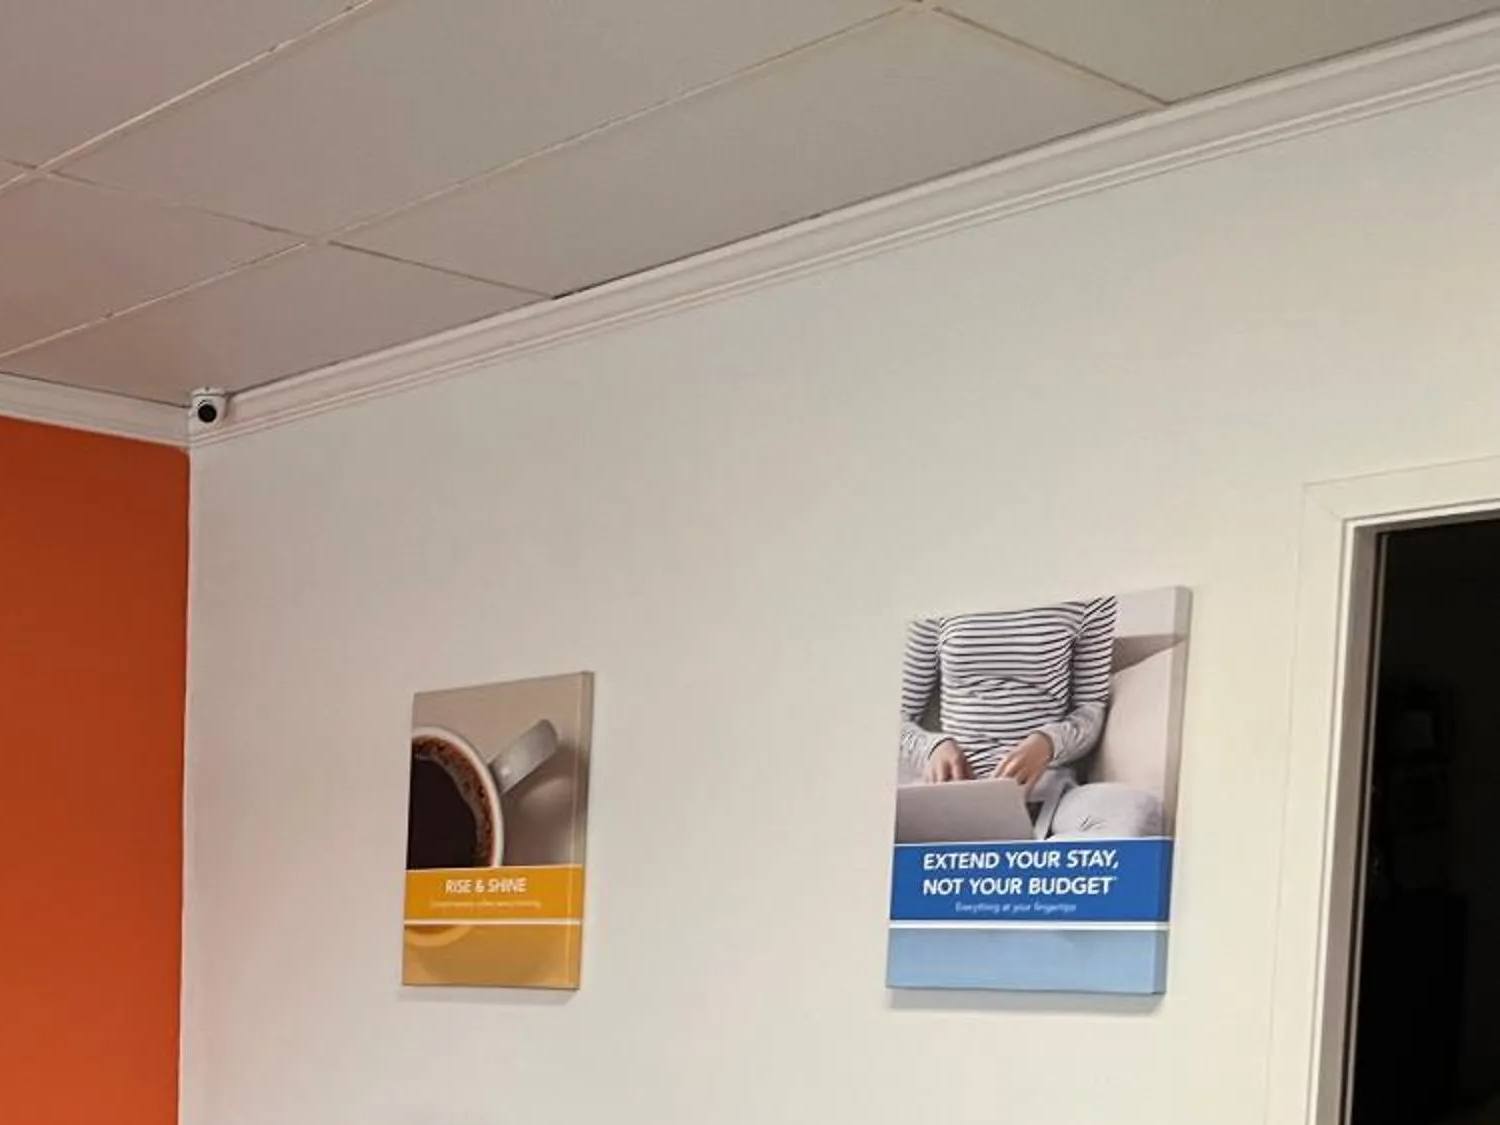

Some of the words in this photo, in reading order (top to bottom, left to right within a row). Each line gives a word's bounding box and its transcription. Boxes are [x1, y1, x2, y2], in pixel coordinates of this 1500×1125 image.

[923, 851, 1000, 870] EXTEND
[1005, 850, 1060, 869] YOUR
[1066, 849, 1119, 869] STAY,
[445, 878, 473, 894] RISE
[475, 879, 486, 893] &
[487, 876, 527, 893] SHINE
[923, 878, 964, 896] NOT
[969, 877, 1022, 895] YOUR
